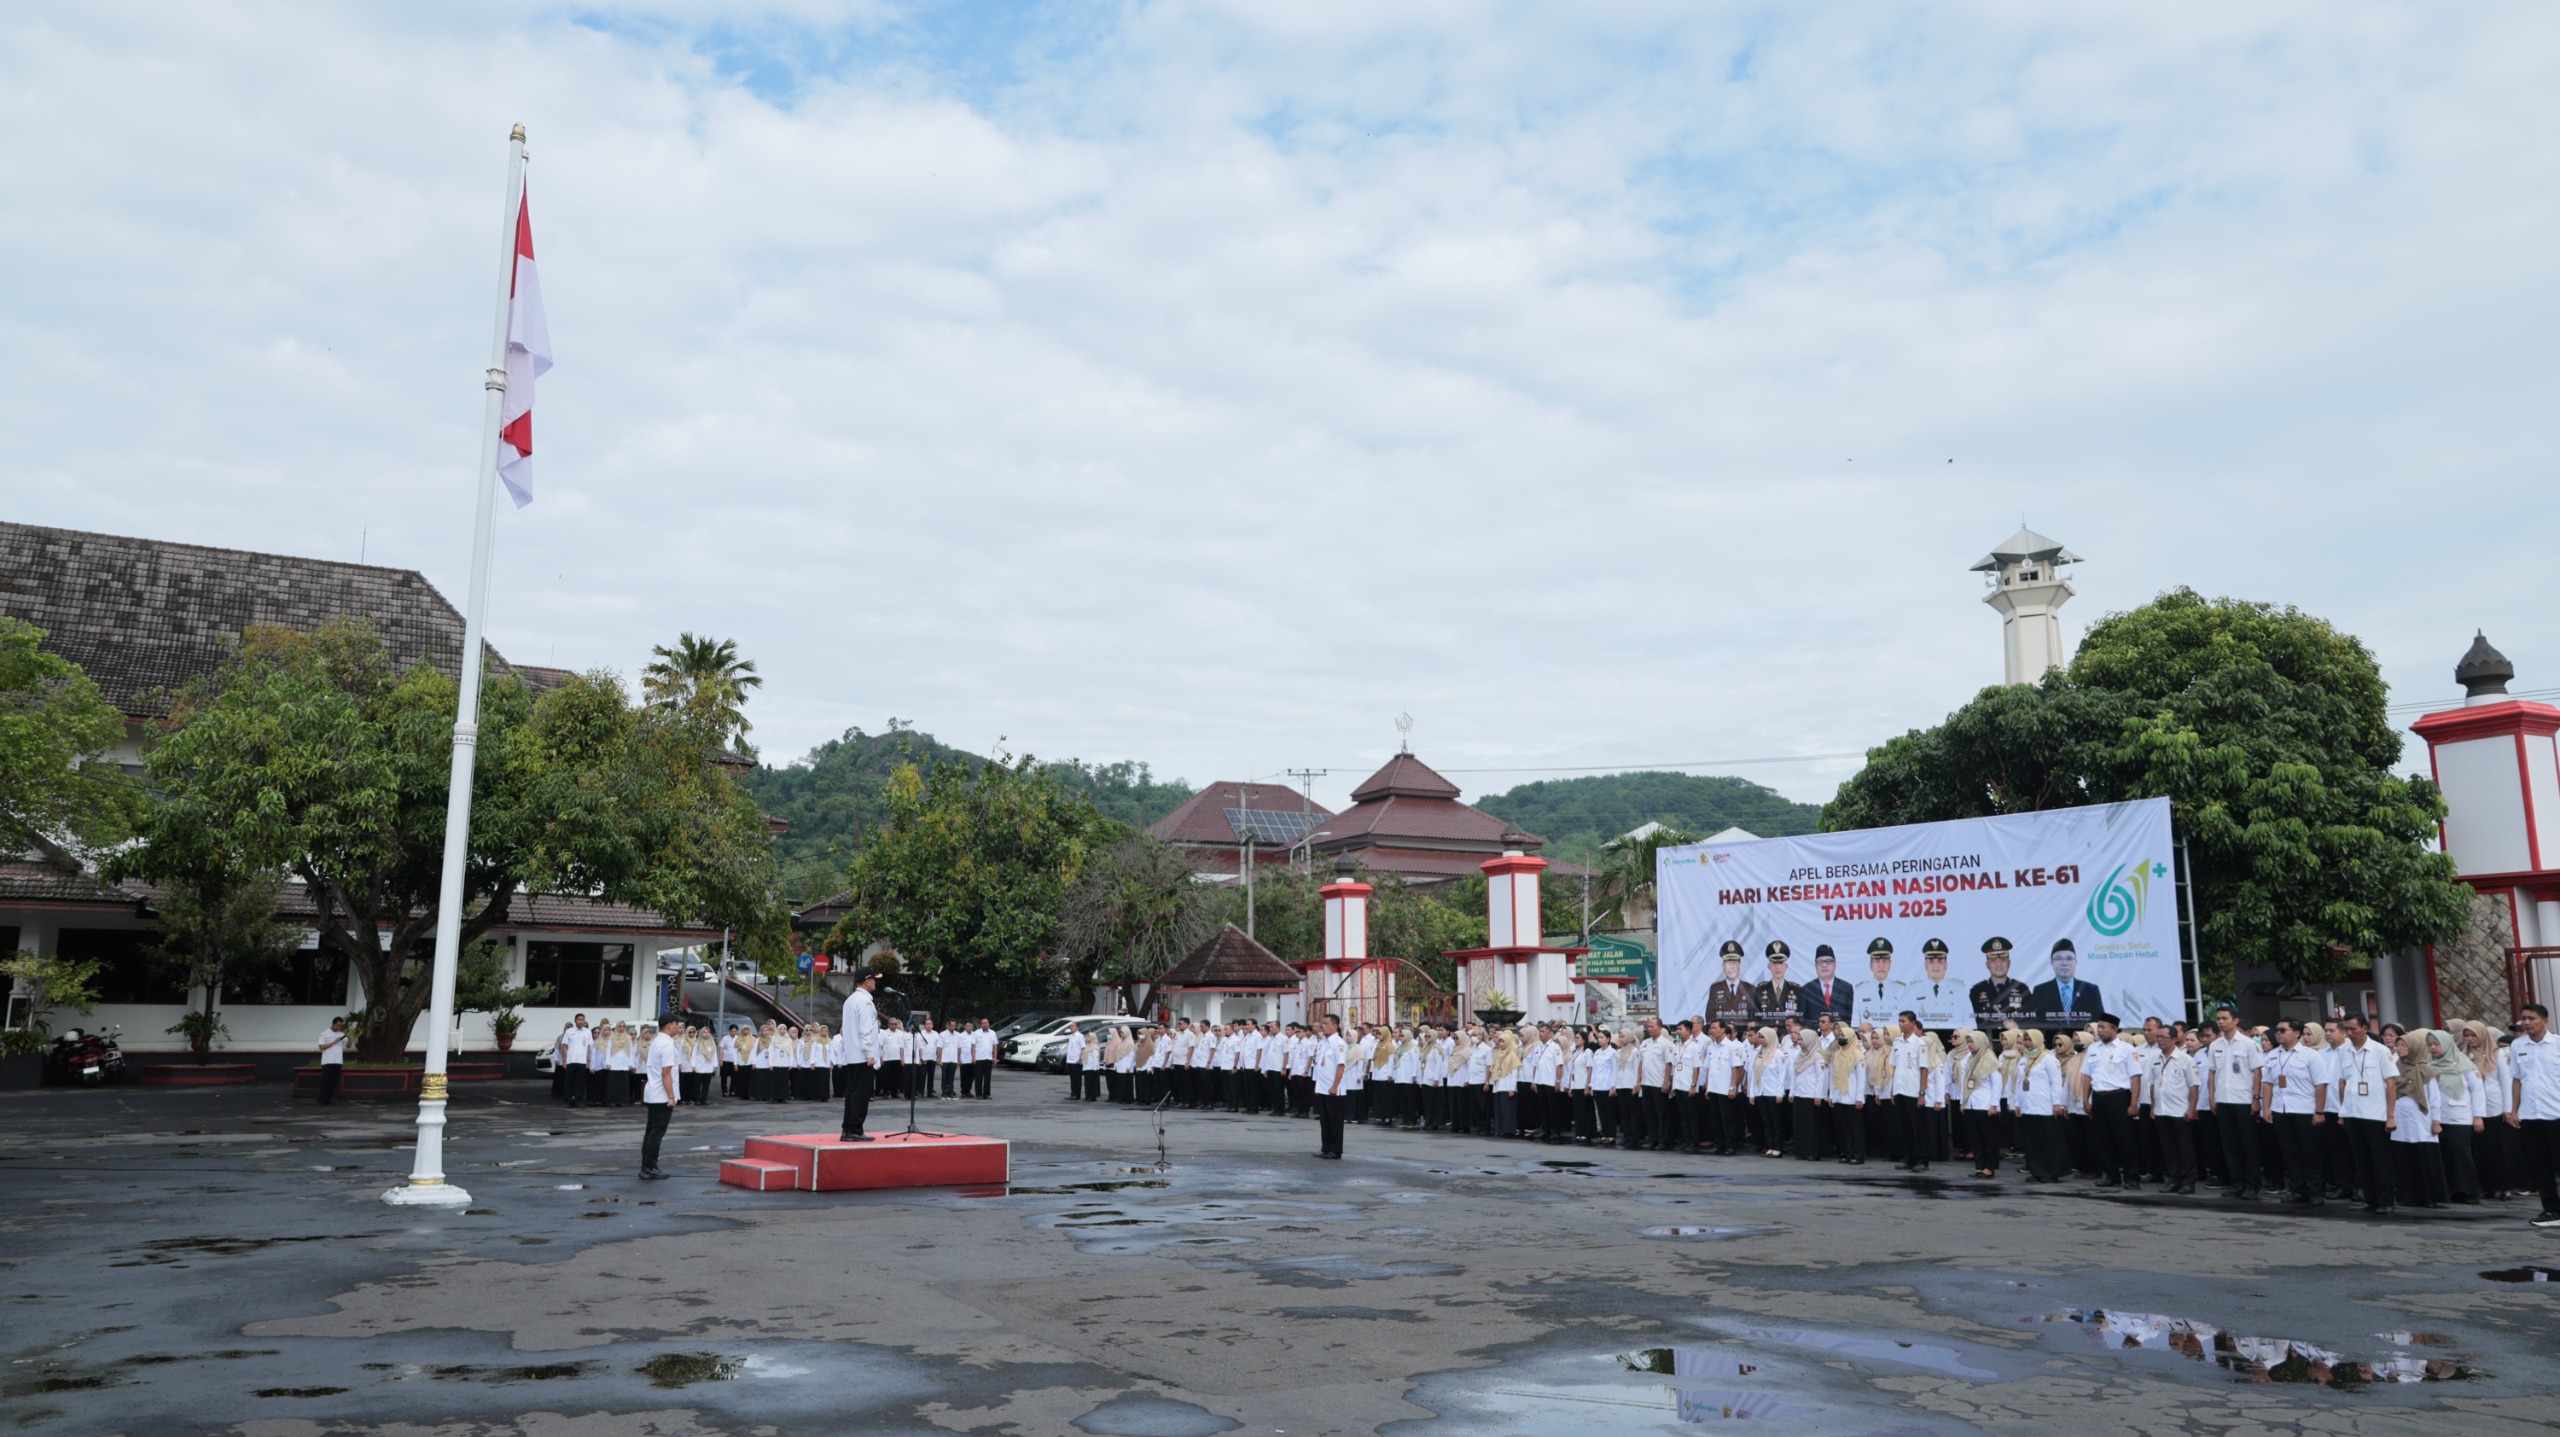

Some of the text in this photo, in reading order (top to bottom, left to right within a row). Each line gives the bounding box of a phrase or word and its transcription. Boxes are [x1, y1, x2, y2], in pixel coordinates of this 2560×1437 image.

[1788, 854, 1981, 881] APEL BERSAMA PERINGATAN
[1718, 864, 2080, 906] HARI KESEHATAN NASIONAL KE-61
[1821, 898, 1948, 921] TAHUN 2025
[1602, 950, 1624, 958] JALAN
[2087, 950, 2159, 960] Masa Depan Hebat
[2093, 942, 2151, 952] Generasi Sehat
